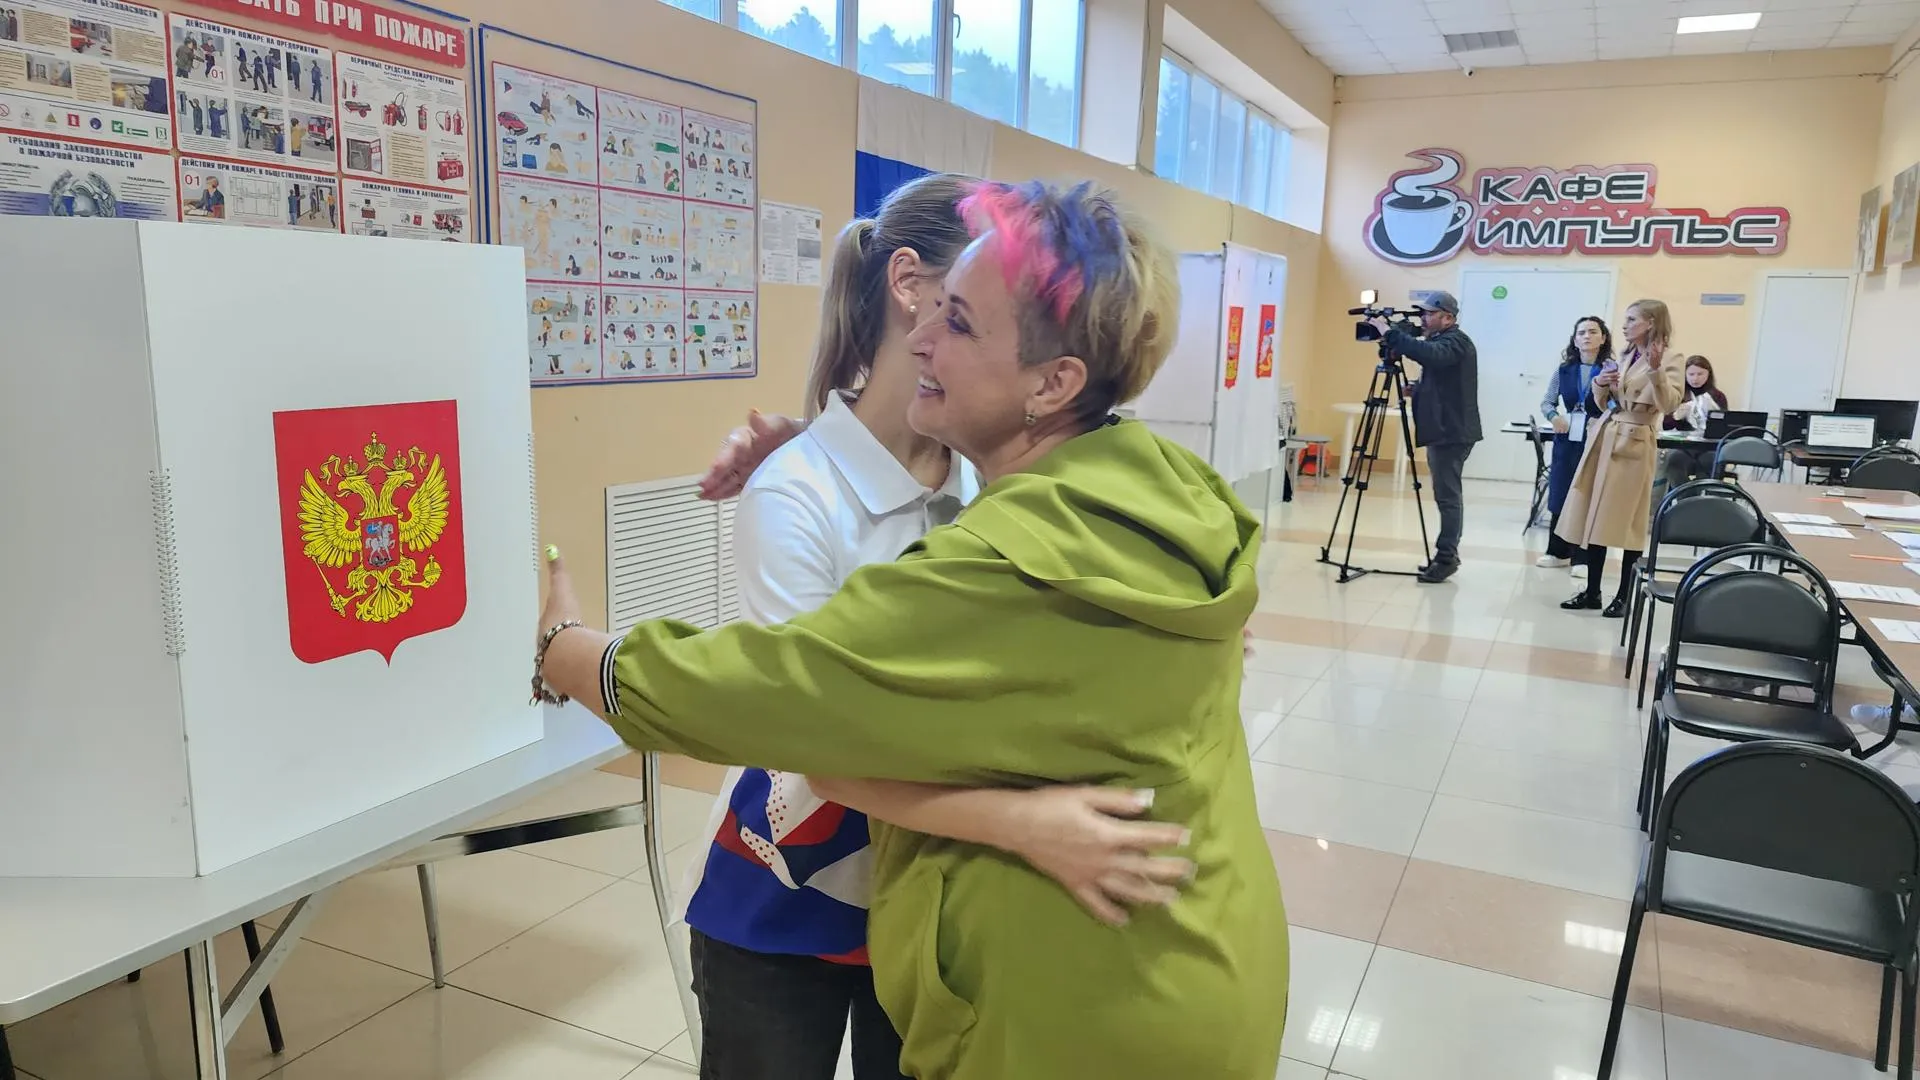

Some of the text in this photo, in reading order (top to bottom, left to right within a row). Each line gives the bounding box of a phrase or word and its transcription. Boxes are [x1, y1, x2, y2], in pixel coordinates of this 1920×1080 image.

[185, 19, 221, 33] ДЕЙСТВИЯ
[223, 27, 236, 36] ПРИ
[238, 31, 264, 43] ПОЖАРЕ
[314, 0, 362, 32] ПРИ
[374, 13, 459, 57] ПОЖАРЕ
[211, 69, 225, 81] 01
[8, 136, 61, 150] ТРЕБОВАНИЯ
[75, 155, 135, 168] БЕЗОПАСНОСТИ
[181, 158, 215, 169] ДЕЙСТВИЯ
[217, 163, 230, 171] ПРИ
[231, 165, 257, 175] ПОЖАРЕ
[184, 174, 200, 186] 01
[1480, 172, 1648, 204] КАФЕ
[1477, 215, 1781, 248] ИМПУЛЬС
